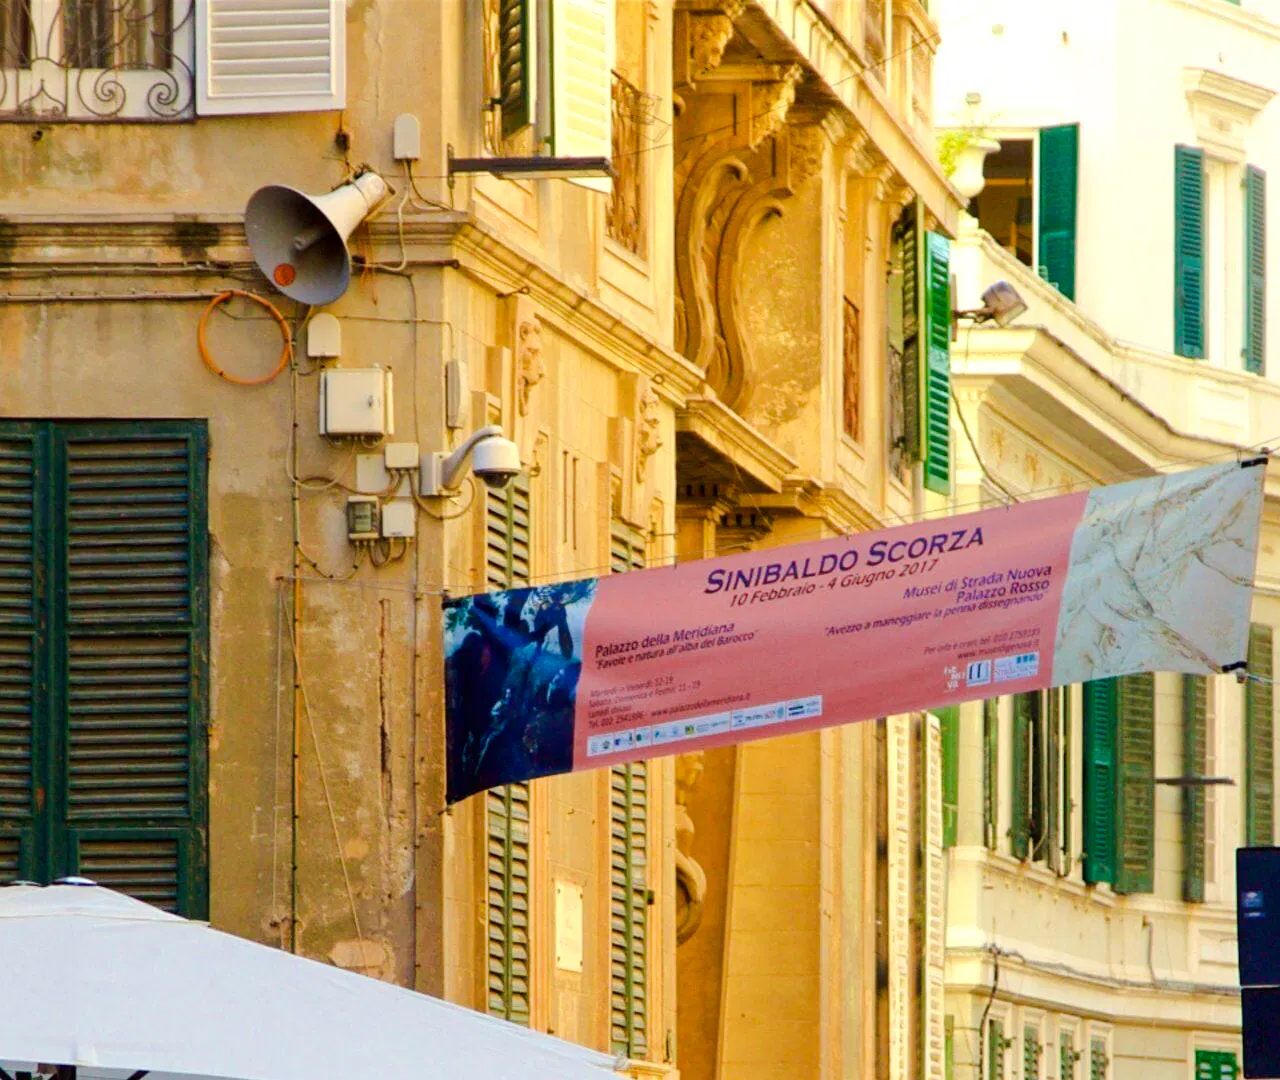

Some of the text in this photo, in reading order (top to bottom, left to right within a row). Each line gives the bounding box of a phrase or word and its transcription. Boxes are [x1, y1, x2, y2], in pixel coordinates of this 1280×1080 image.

[704, 527, 984, 594] SINIBALDO SCORZA
[730, 593, 748, 608] 10
[752, 583, 816, 603] Febbraio
[827, 578, 838, 590] 4
[841, 567, 895, 589] Giugno
[898, 558, 939, 578] 2017
[903, 566, 1052, 600] Musei di Strada Nuova
[955, 579, 1050, 603] Palazzo Rosso
[873, 611, 930, 628] maneggiare
[944, 604, 977, 620] penna
[595, 623, 735, 658] Palazzo della Meridiana
[635, 649, 665, 663] natura
